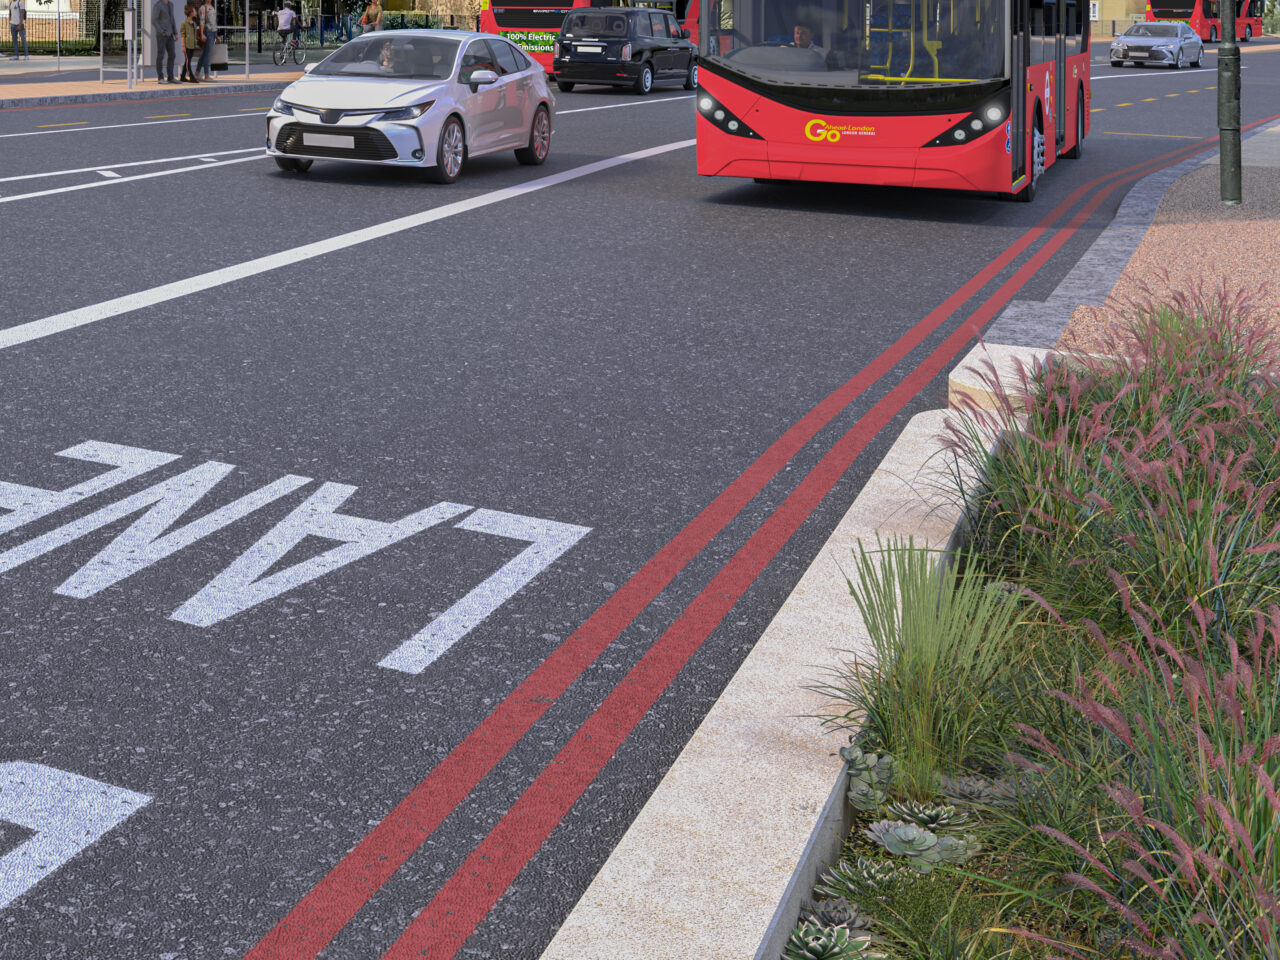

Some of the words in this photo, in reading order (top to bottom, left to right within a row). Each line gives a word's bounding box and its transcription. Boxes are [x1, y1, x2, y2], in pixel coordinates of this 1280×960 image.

[506, 33, 527, 41] 100%
[528, 33, 556, 41] Electric
[805, 119, 841, 142] Go
